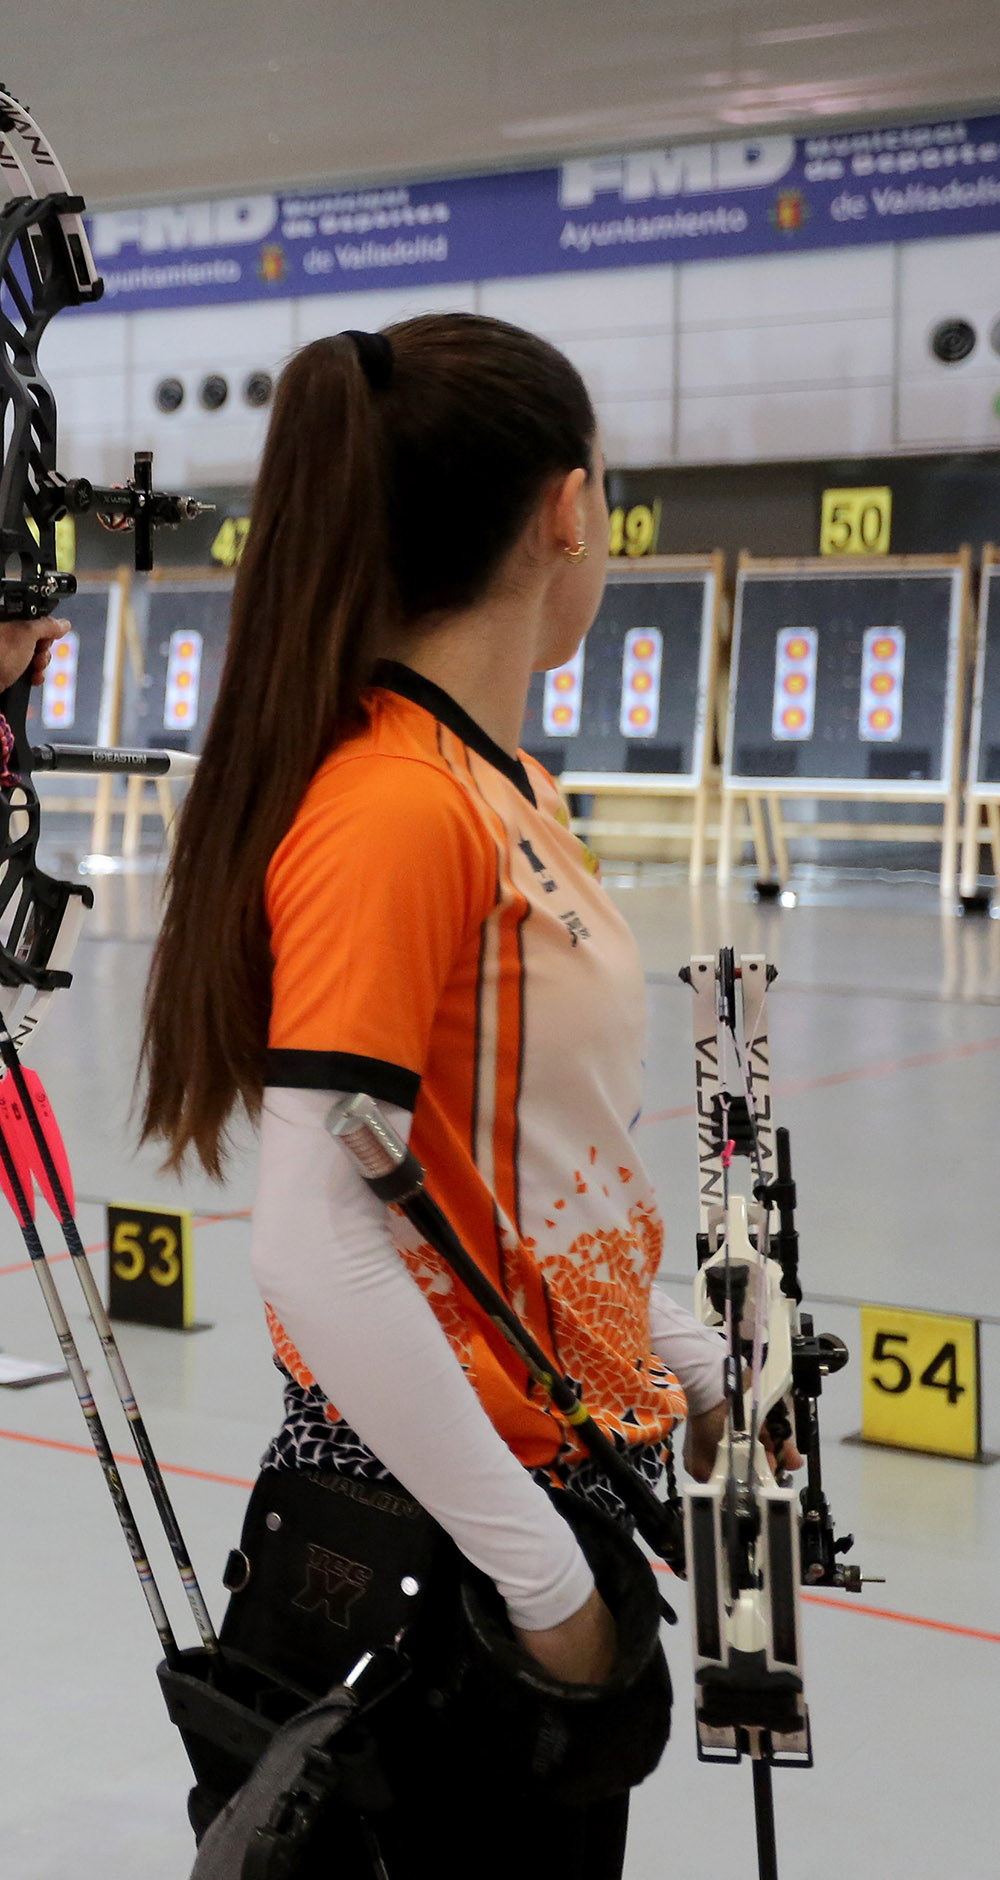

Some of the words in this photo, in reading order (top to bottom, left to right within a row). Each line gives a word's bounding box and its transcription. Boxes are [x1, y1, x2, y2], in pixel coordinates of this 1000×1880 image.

[560, 135, 796, 209] FMD
[92, 194, 278, 259] FMD
[560, 207, 748, 253] Ayuntamiento
[830, 190, 868, 222] de
[98, 258, 242, 297] yuntamiento
[335, 233, 448, 271] Valladolid
[830, 503, 883, 551] 50
[112, 1221, 182, 1288] 53
[871, 1331, 967, 1405] 54
